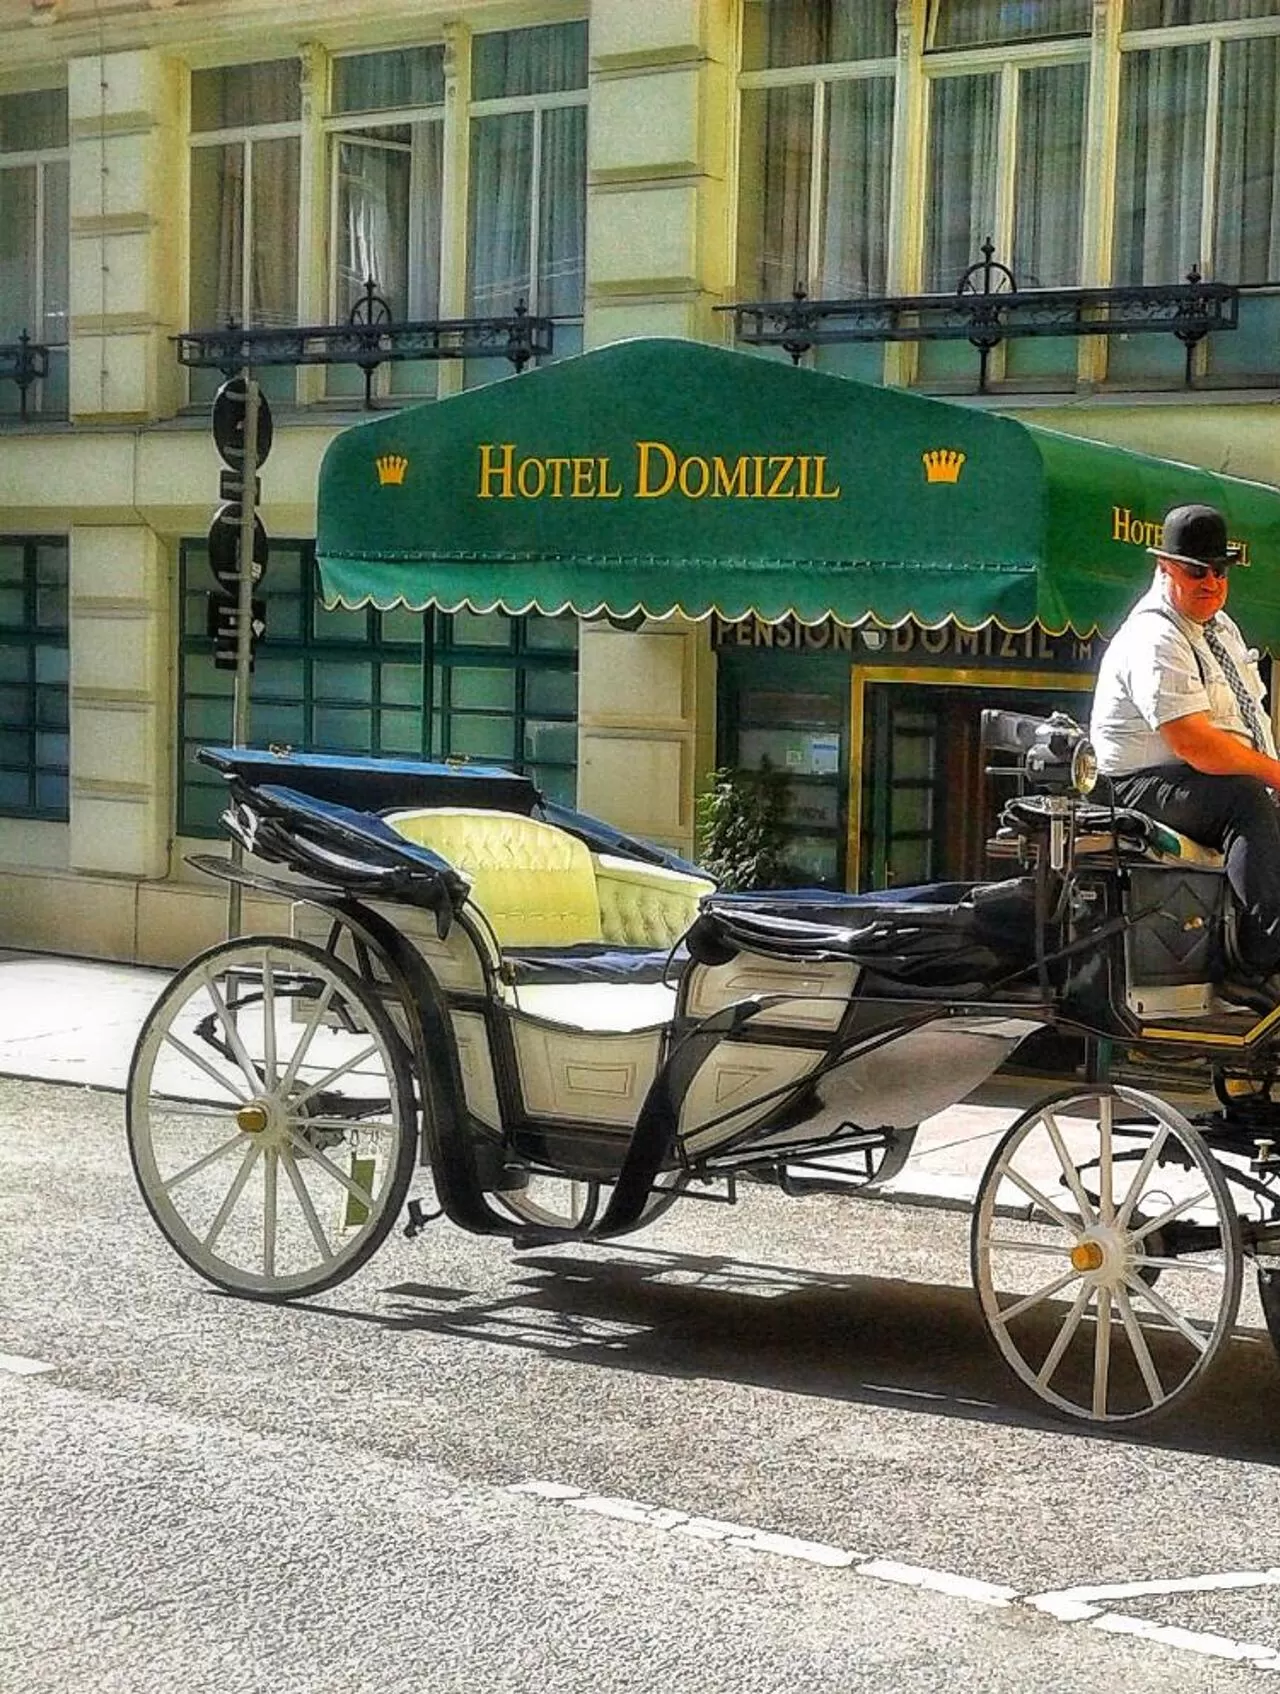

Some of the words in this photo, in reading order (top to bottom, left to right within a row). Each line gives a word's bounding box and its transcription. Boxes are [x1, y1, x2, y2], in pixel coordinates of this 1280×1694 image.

[476, 443, 623, 499] HOTEL
[633, 440, 841, 498] DOMIZIL
[1111, 506, 1165, 547] HOTE
[716, 618, 852, 650] PENSION
[891, 622, 1054, 659] DOMIZIL
